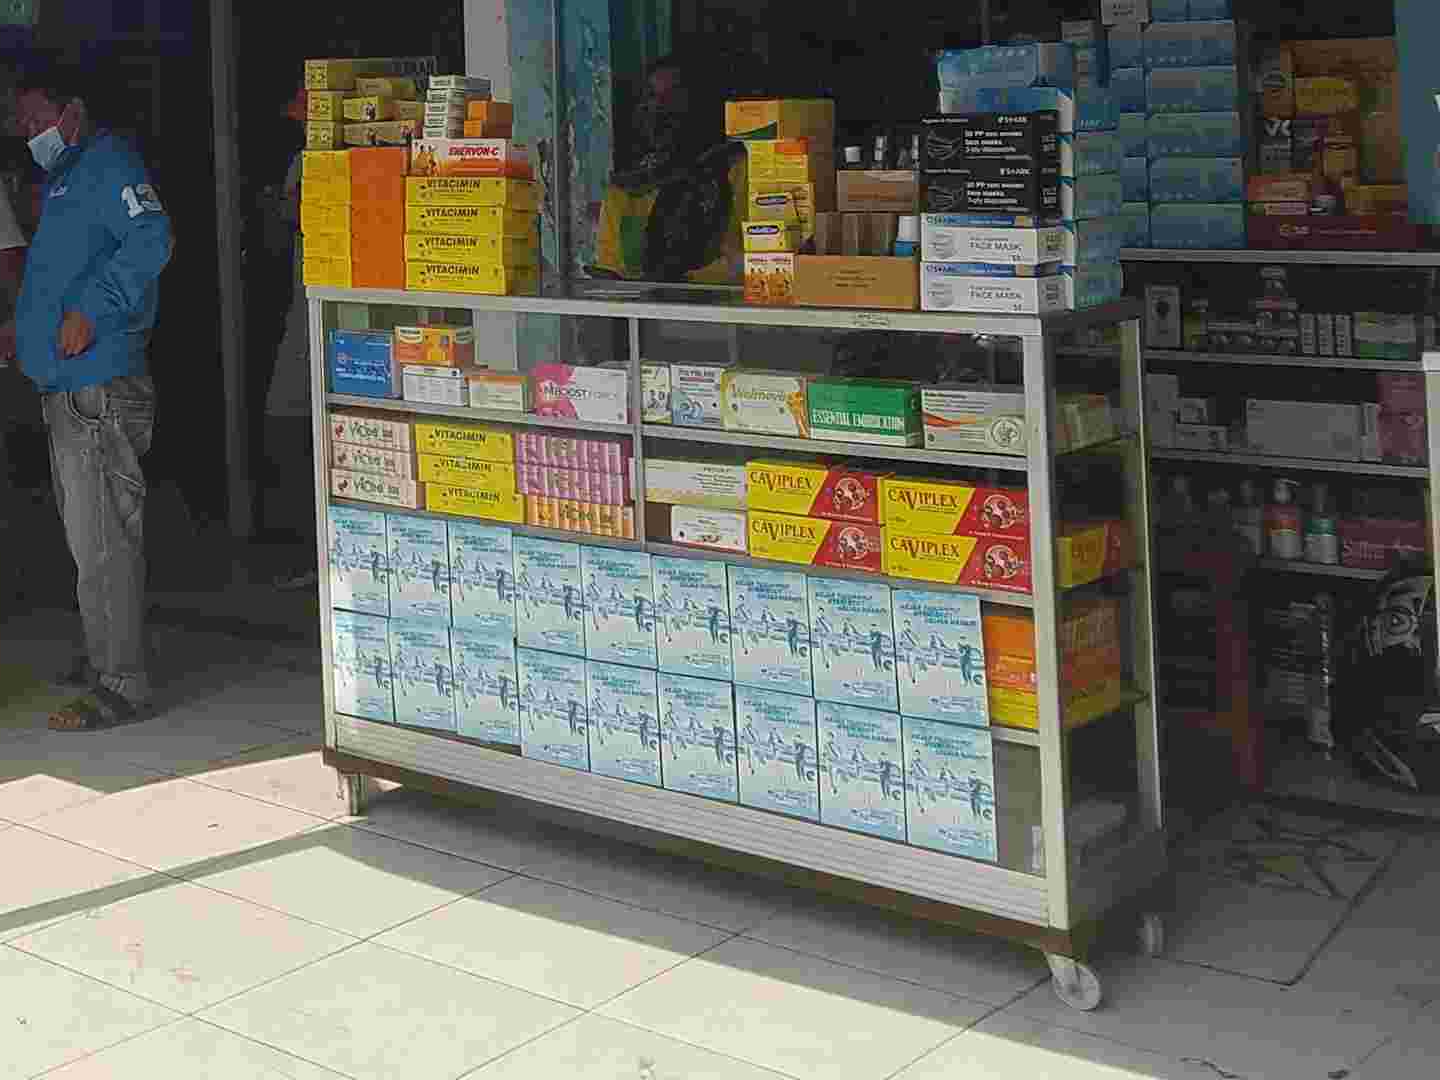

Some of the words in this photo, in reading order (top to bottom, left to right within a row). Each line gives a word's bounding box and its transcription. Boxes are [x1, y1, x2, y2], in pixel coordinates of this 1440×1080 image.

[427, 178, 481, 189] VITACIMIN
[425, 207, 480, 217] VITACIMIN
[424, 237, 478, 248] VITACIMIN
[426, 264, 480, 275] VITACIMIN
[434, 429, 487, 442] VITACIMIN
[440, 458, 492, 472] VITACIMIN
[750, 471, 812, 492] CAVIPLEX
[449, 487, 501, 502] VITACIMIN
[888, 487, 960, 510] CAVIPLEX
[751, 520, 816, 541] CAVIPLEX
[890, 537, 961, 559] CAVIPLEX
